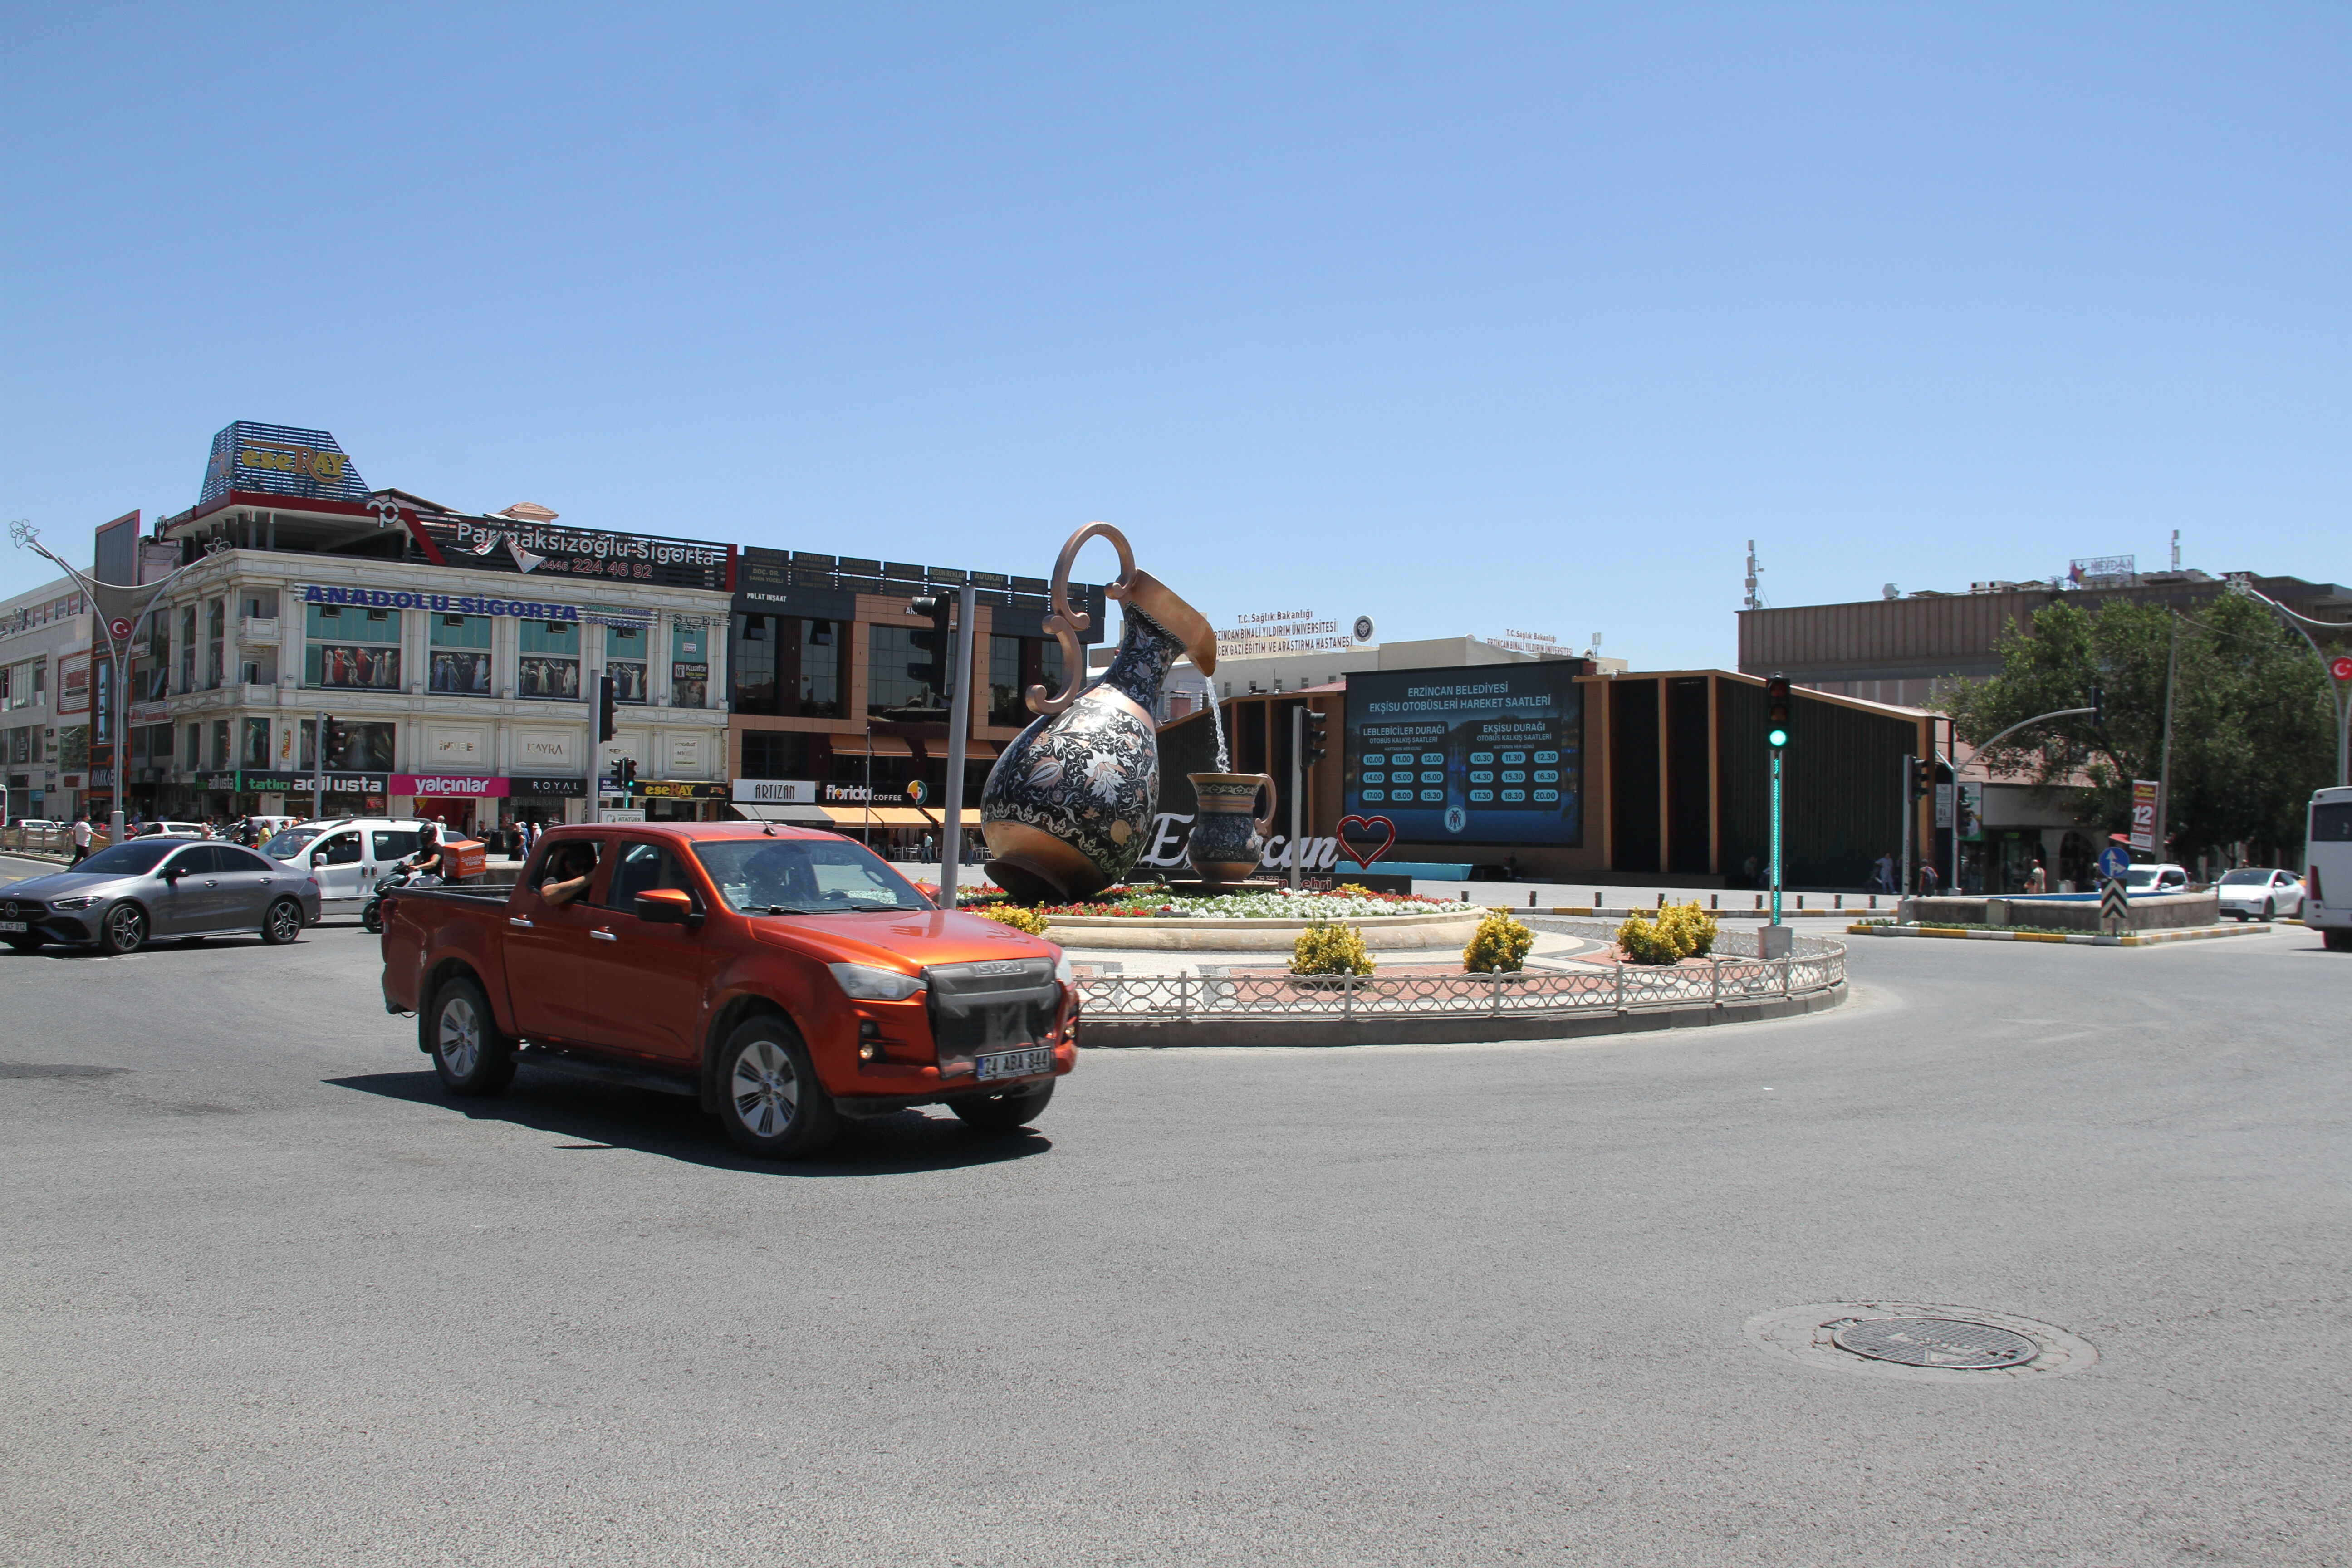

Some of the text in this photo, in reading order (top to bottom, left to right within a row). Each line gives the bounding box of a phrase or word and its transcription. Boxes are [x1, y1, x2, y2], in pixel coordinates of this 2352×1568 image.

[637, 540, 714, 565] Sigorta
[797, 553, 832, 563] AVUKAT
[540, 558, 652, 579] 0446 224 46 92
[843, 559, 876, 568] AVUKAT
[947, 570, 966, 578] REKLAM
[975, 573, 1004, 582] AVUKAT
[843, 578, 876, 587] AVUKAT
[304, 585, 579, 621] ANADOLU SİGORTA
[747, 593, 765, 601] POLAT
[1238, 609, 1313, 624] T.C. Sağlık Bakanlığı
[1214, 618, 1336, 641] RZİNCAN BİNALİ YILDIRIM ÜNİVERSİTESİ
[1230, 641, 1244, 656] GAZİ
[1245, 640, 1266, 654] EĞİTİM
[1269, 642, 1276, 652] VE
[1278, 639, 1314, 653] ARAŞTIRMA
[1316, 632, 1352, 649] HASTANESİ
[686, 664, 707, 672] Kuaför
[1408, 681, 1508, 697] ERZİNCAN BELEDİYESİ
[1370, 694, 1551, 715] EKŞİSU OTOBÜSLERİ HAREKET SAATLERİ
[1363, 724, 1445, 736] LEBLEBİCİLER DURAĞI
[1483, 721, 1545, 735] EKŞİSU DURAĞI
[1502, 734, 1523, 742] KALKIŞ
[1524, 732, 1552, 740] SAATLERİ
[527, 743, 563, 755] KAYRA
[220, 774, 234, 790] usta
[249, 778, 291, 790] tatlıcı
[333, 776, 382, 792] usta
[415, 777, 489, 795] yalçınlar
[533, 781, 579, 790] ROYAL
[755, 784, 795, 799] ARTIZAN
[826, 784, 872, 801] florida
[2133, 805, 2153, 825] 12
[1299, 877, 1332, 890] ehri
[973, 961, 1022, 974] ISUZU
[985, 1050, 1048, 1074] 24 ABA 844
